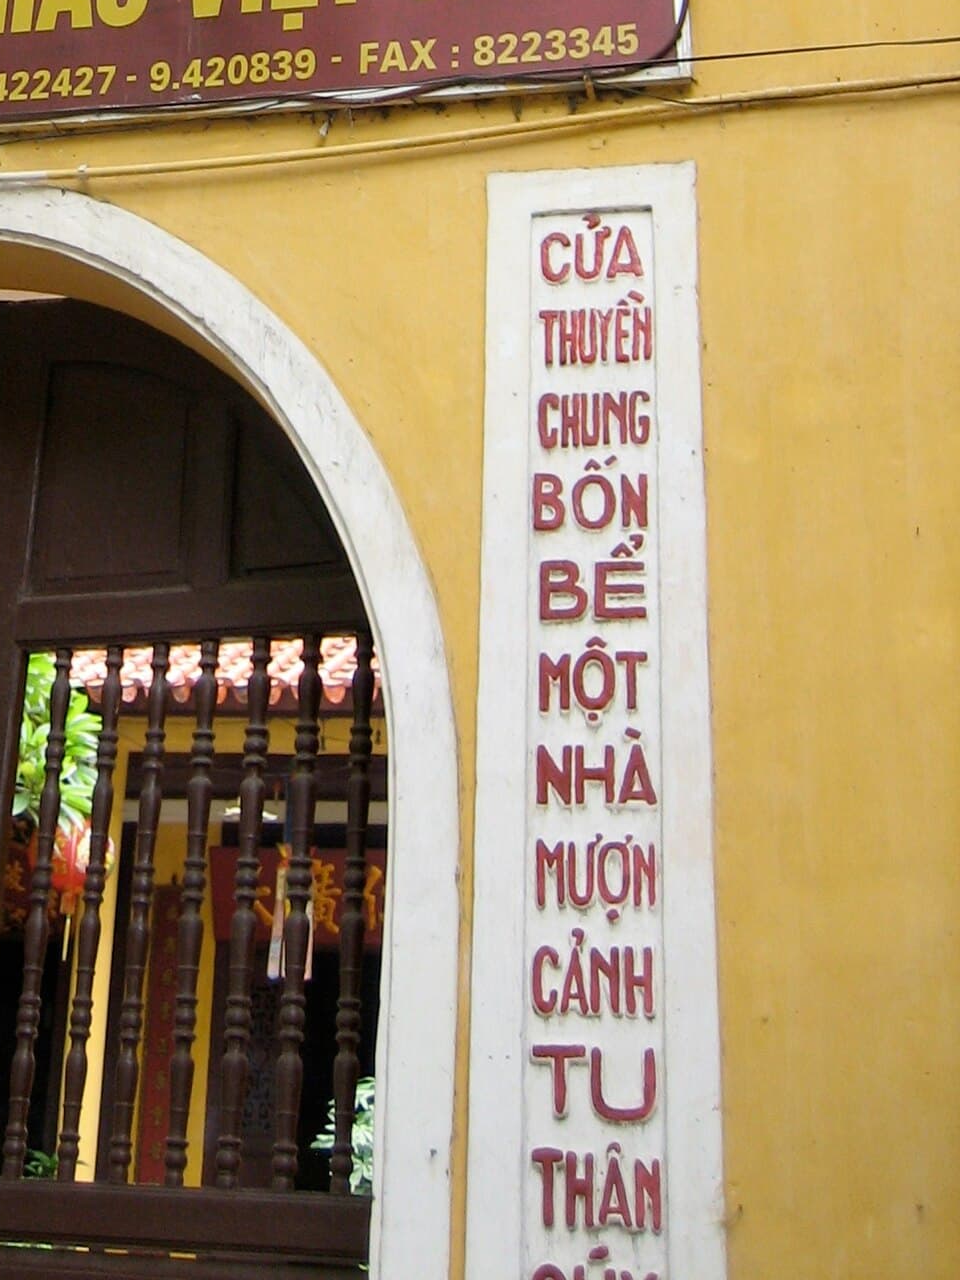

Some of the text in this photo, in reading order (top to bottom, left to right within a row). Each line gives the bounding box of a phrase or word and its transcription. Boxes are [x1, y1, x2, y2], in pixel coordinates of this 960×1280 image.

[149, 48, 317, 92] 9.420839
[359, 38, 438, 74] FAX
[473, 23, 639, 67] 8223345
[540, 213, 645, 284] CỬA
[539, 289, 652, 366] THUYỀN
[537, 391, 651, 450] CHUNG
[533, 455, 648, 531] BỐN
[540, 533, 648, 621] BỂ
[539, 636, 648, 722] MỘT
[537, 728, 657, 805] NHÀ
[537, 833, 657, 923] MƯỢN
[532, 928, 654, 1016] CẢNH
[532, 1044, 657, 1119] TU
[531, 1142, 662, 1230] THÂN
